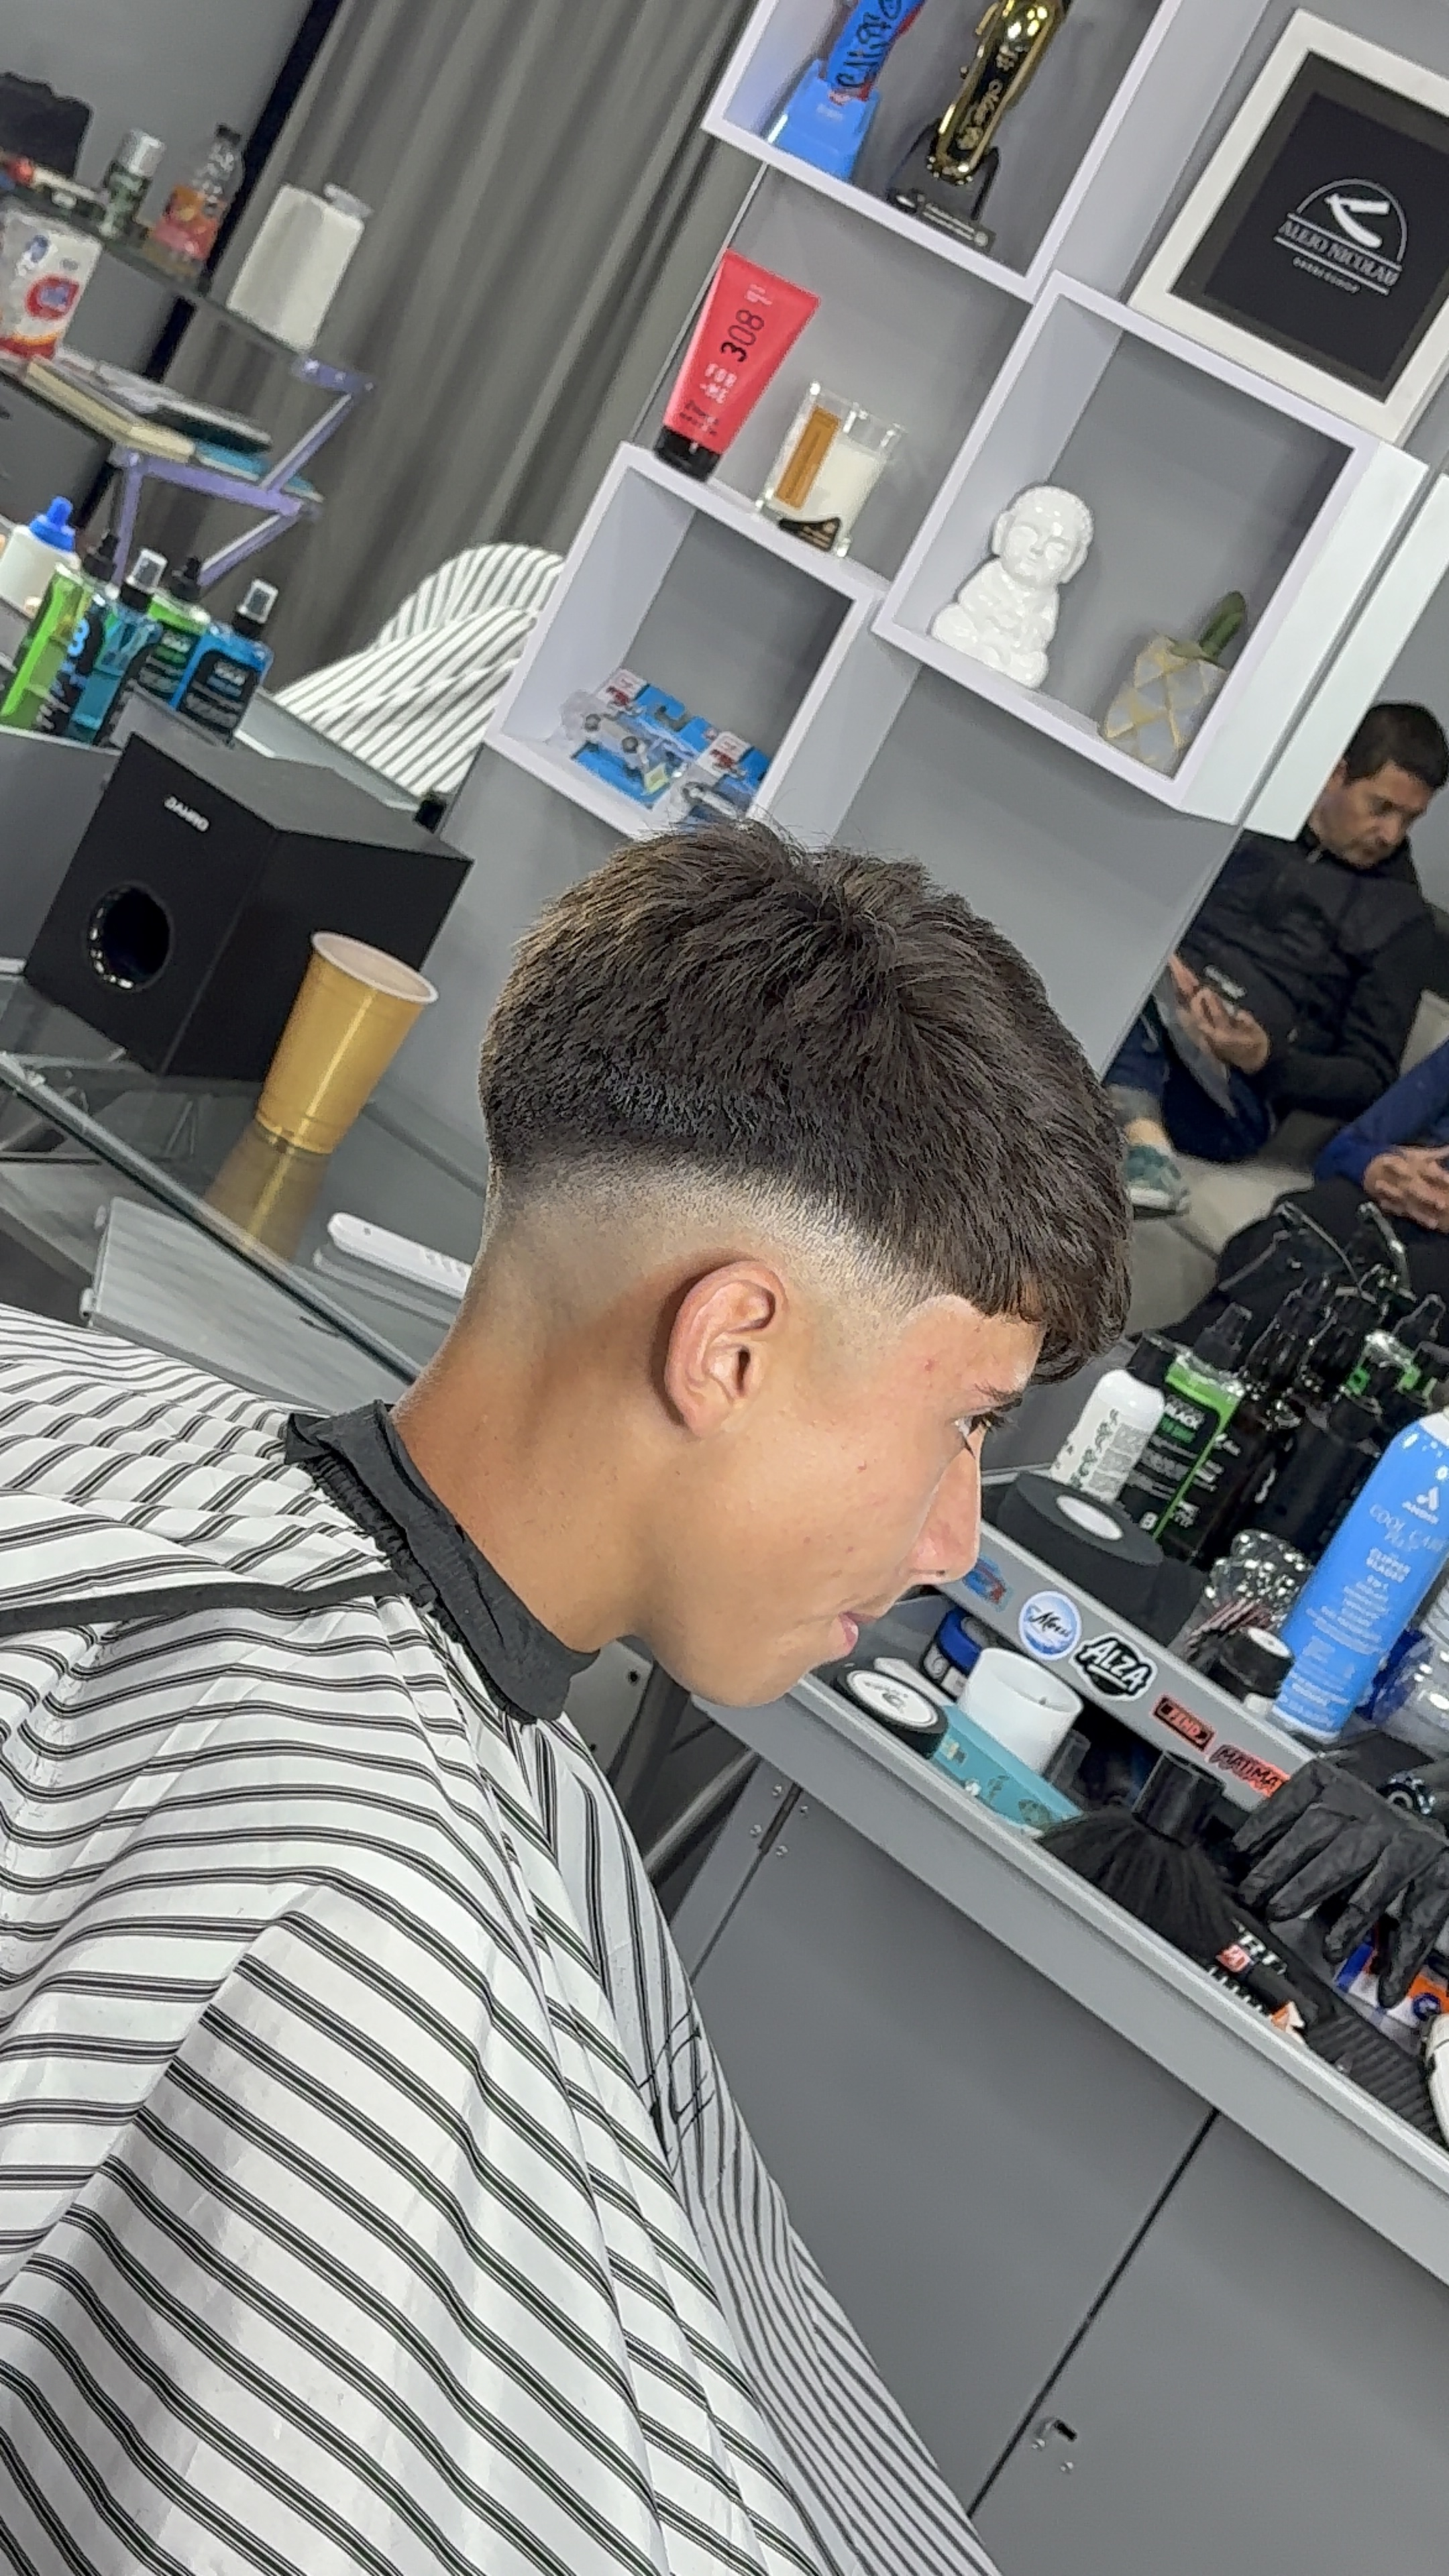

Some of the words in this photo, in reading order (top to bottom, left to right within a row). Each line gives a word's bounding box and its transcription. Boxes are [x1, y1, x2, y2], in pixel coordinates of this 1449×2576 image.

[1279, 221, 1328, 252] ALEJO
[1328, 244, 1399, 286] NICOLAU
[721, 310, 764, 362] 308
[705, 364, 737, 388] FOR
[1082, 1642, 1149, 1692] ALZA
